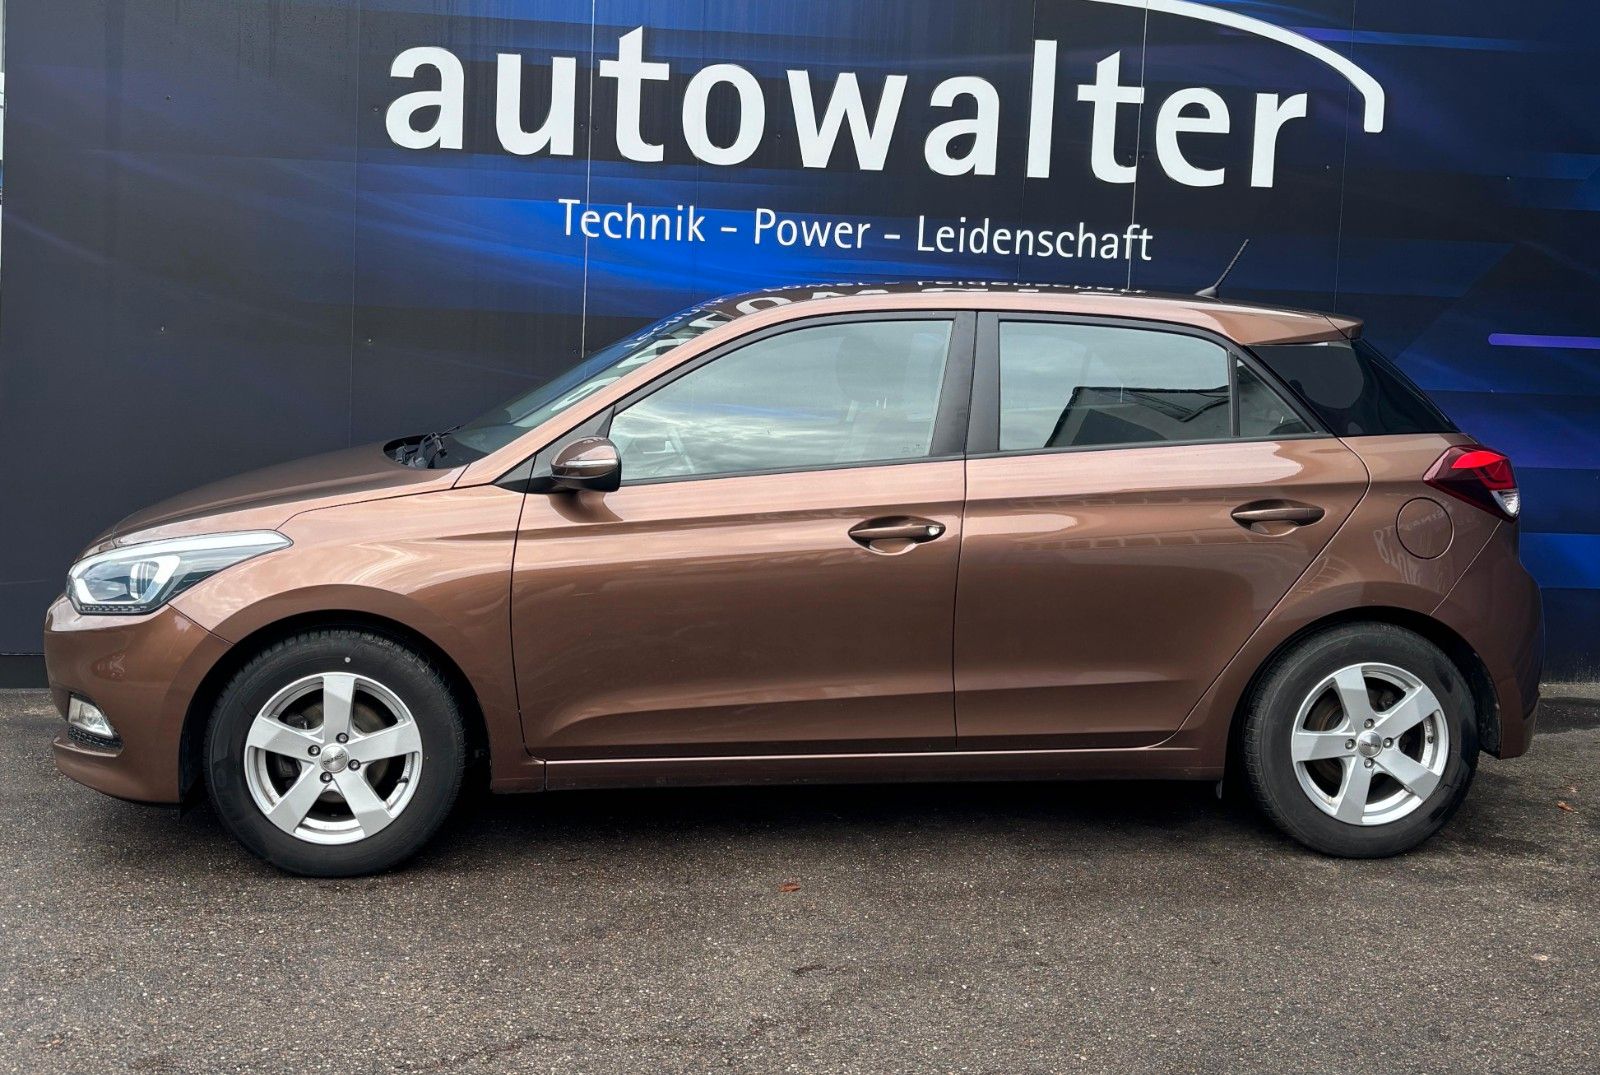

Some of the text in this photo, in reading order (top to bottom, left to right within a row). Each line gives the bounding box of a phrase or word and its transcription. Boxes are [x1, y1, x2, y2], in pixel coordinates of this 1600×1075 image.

[385, 26, 1308, 188] autowalter
[558, 198, 705, 242] Technik
[754, 207, 871, 249] Power
[917, 215, 1153, 261] Leidenschaft
